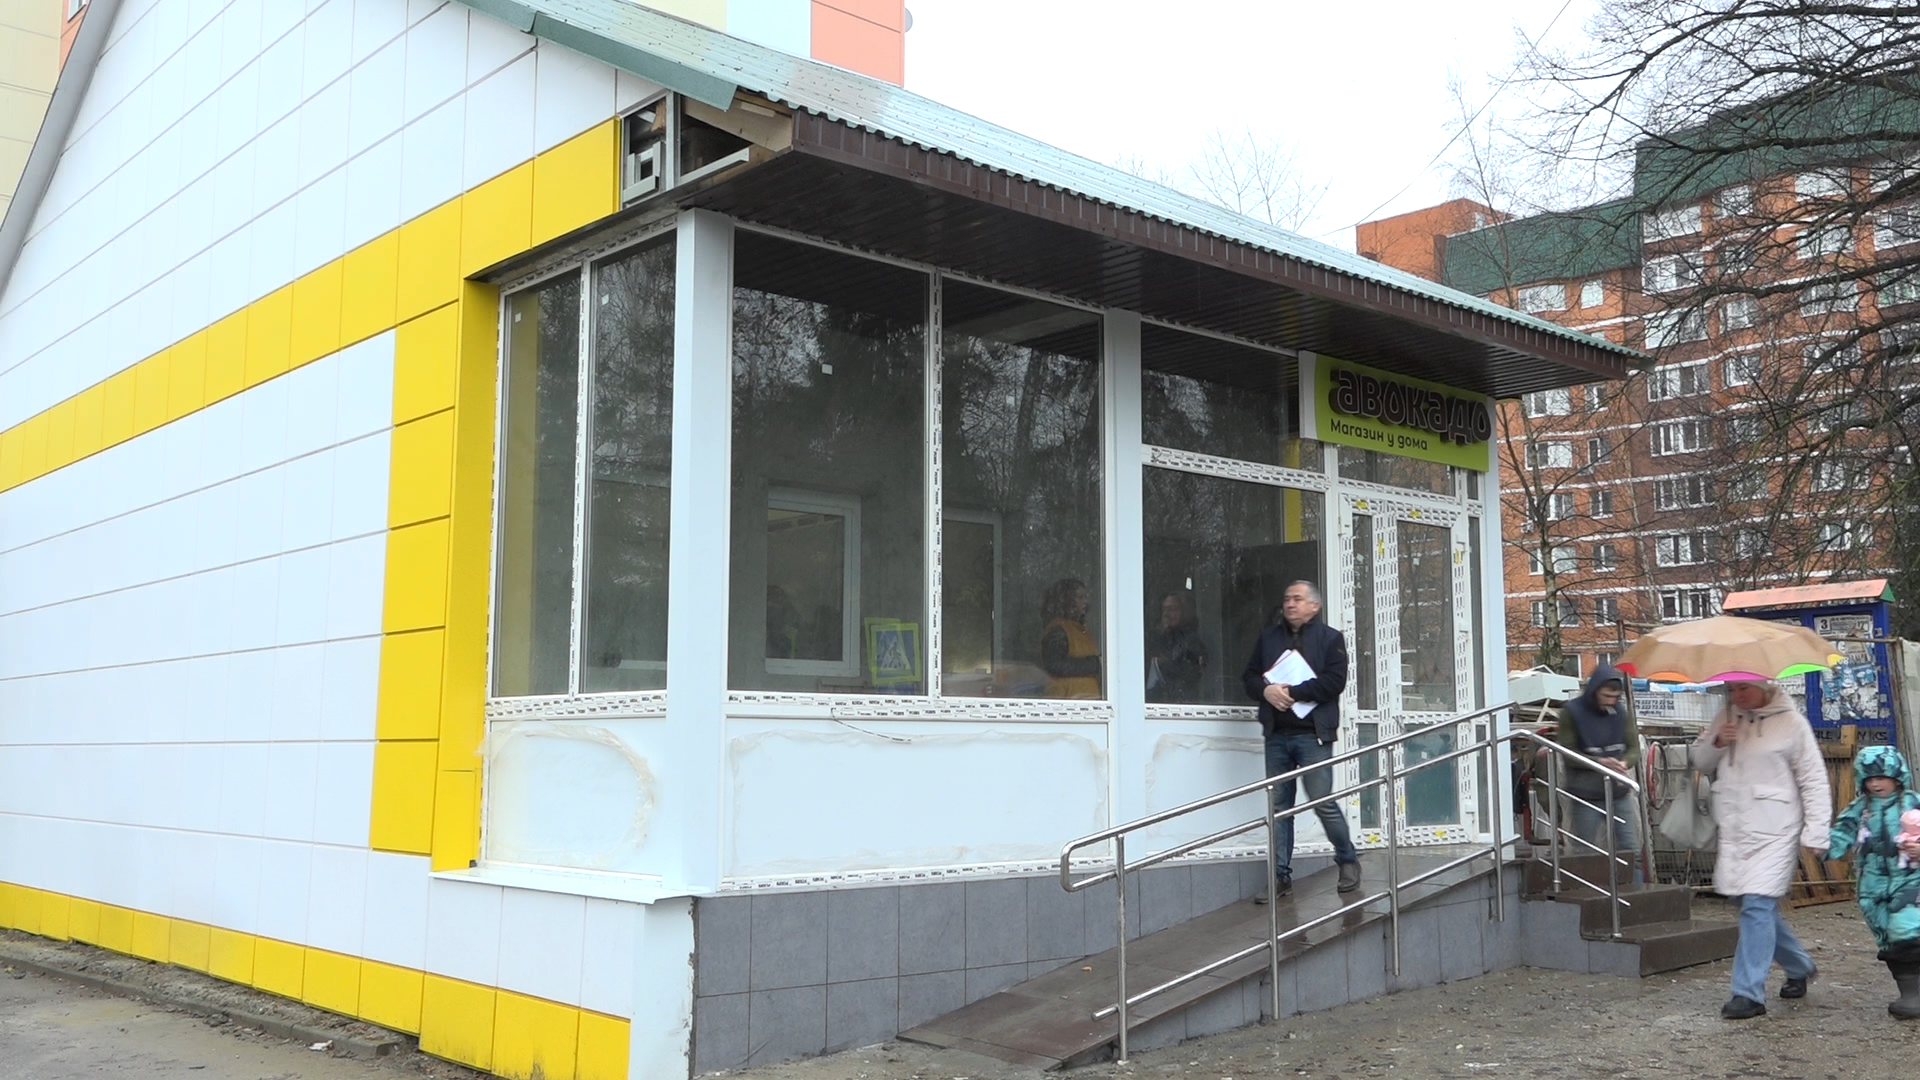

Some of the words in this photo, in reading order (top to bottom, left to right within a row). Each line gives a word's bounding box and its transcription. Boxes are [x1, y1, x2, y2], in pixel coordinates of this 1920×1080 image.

[1329, 369, 1492, 445] авокадо
[1330, 418, 1384, 442] Магазин
[1387, 433, 1395, 448] у
[1397, 434, 1428, 450] дома
